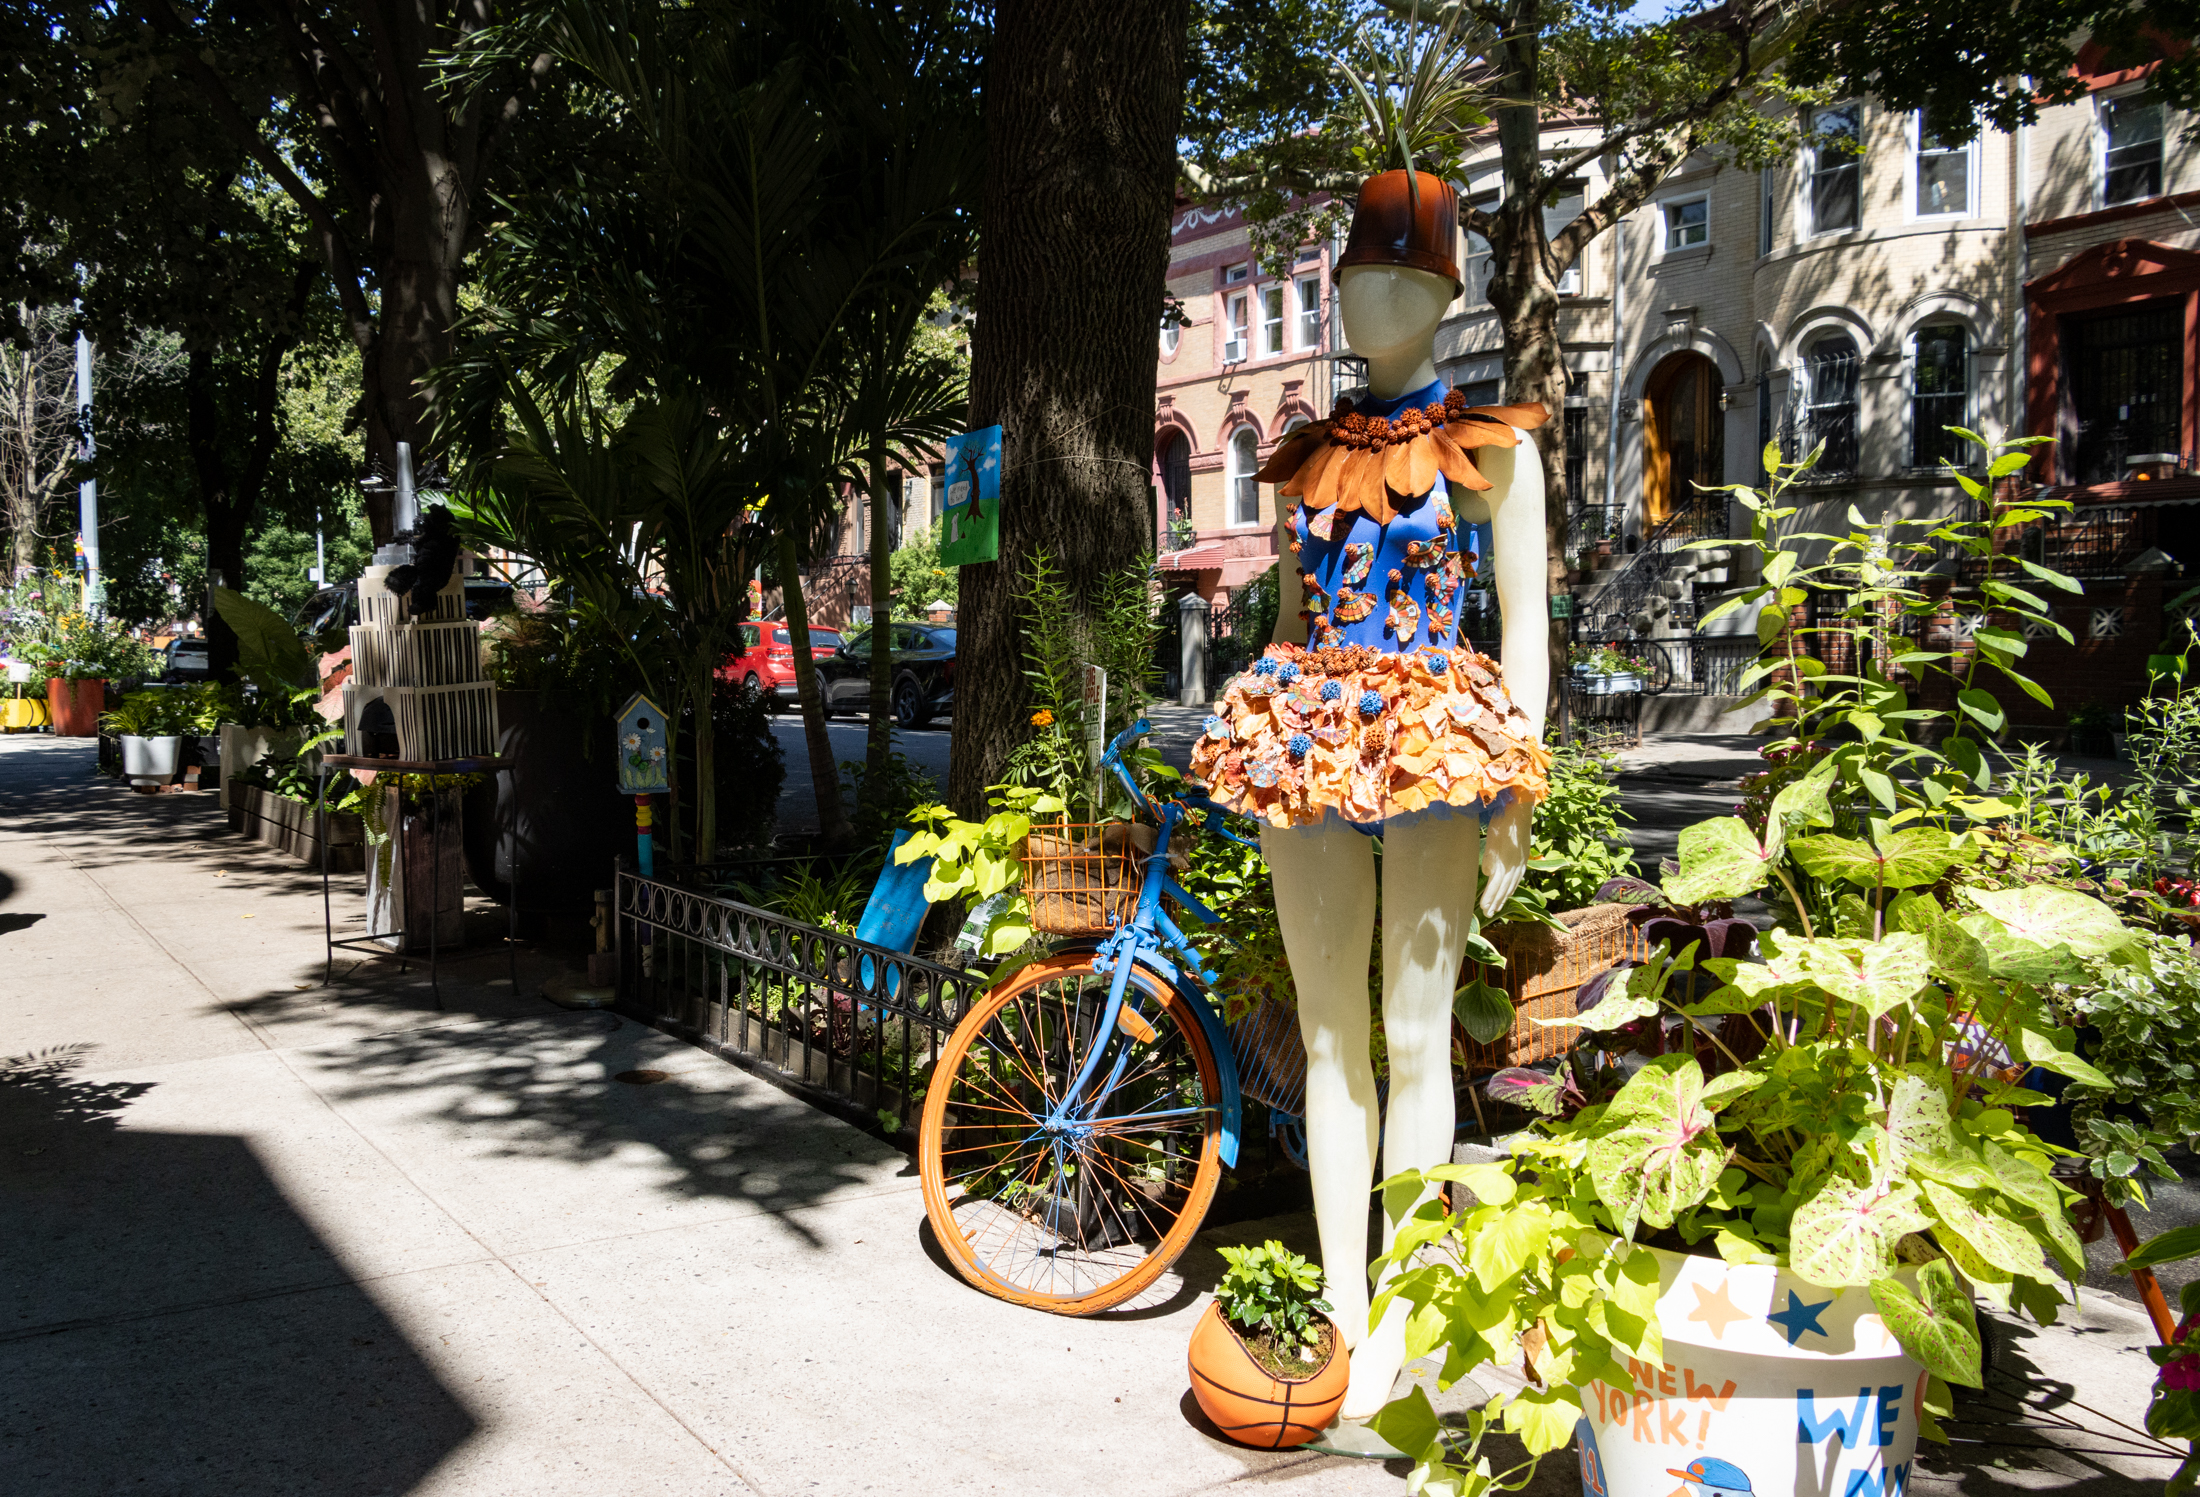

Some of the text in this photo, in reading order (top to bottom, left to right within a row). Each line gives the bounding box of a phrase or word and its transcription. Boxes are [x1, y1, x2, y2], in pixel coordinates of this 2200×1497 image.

[1084, 685, 1100, 705] APPLE
[1085, 666, 1096, 687] BIG
[1628, 1356, 1737, 1412] NEW
[1591, 1379, 1711, 1450] YORK!
[1796, 1384, 1903, 1449] WE
